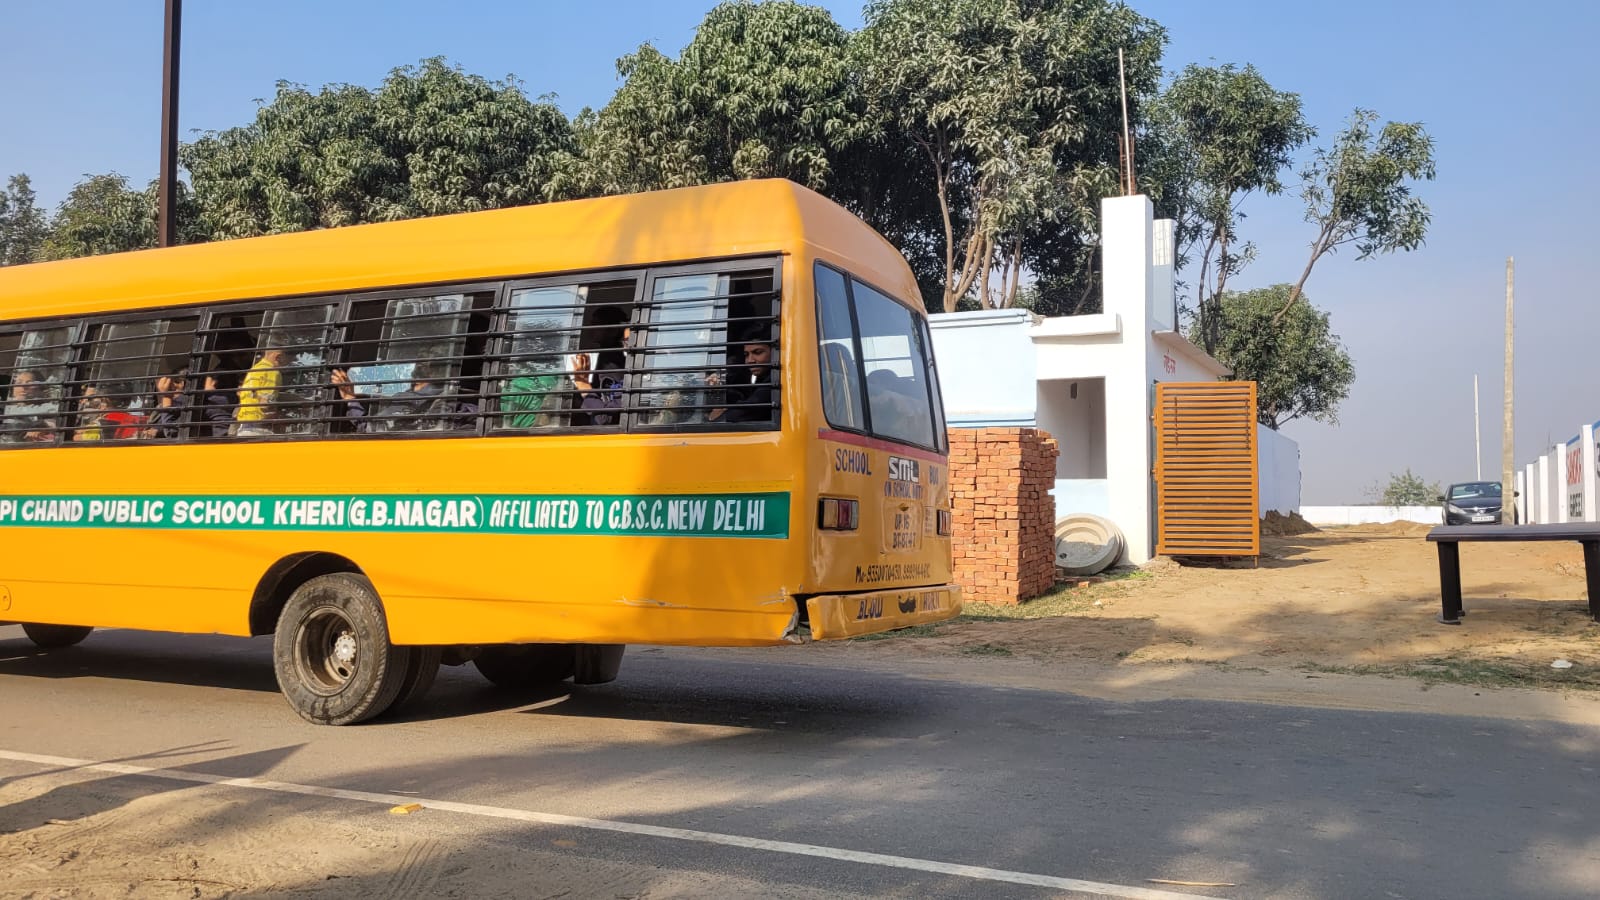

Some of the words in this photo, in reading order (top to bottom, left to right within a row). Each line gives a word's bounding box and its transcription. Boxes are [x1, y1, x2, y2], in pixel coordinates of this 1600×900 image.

[835, 448, 872, 475] SCHOOL
[21, 500, 84, 522] CHAND
[88, 500, 164, 523] PUBLIC
[172, 501, 265, 525] SCHOOL
[273, 500, 345, 525] KHERI
[347, 496, 484, 528] (G.B.NAGAR)
[489, 499, 579, 529] AFFILIATED
[585, 500, 604, 528] TO
[667, 500, 707, 530] NEW
[712, 499, 766, 531] DELHI
